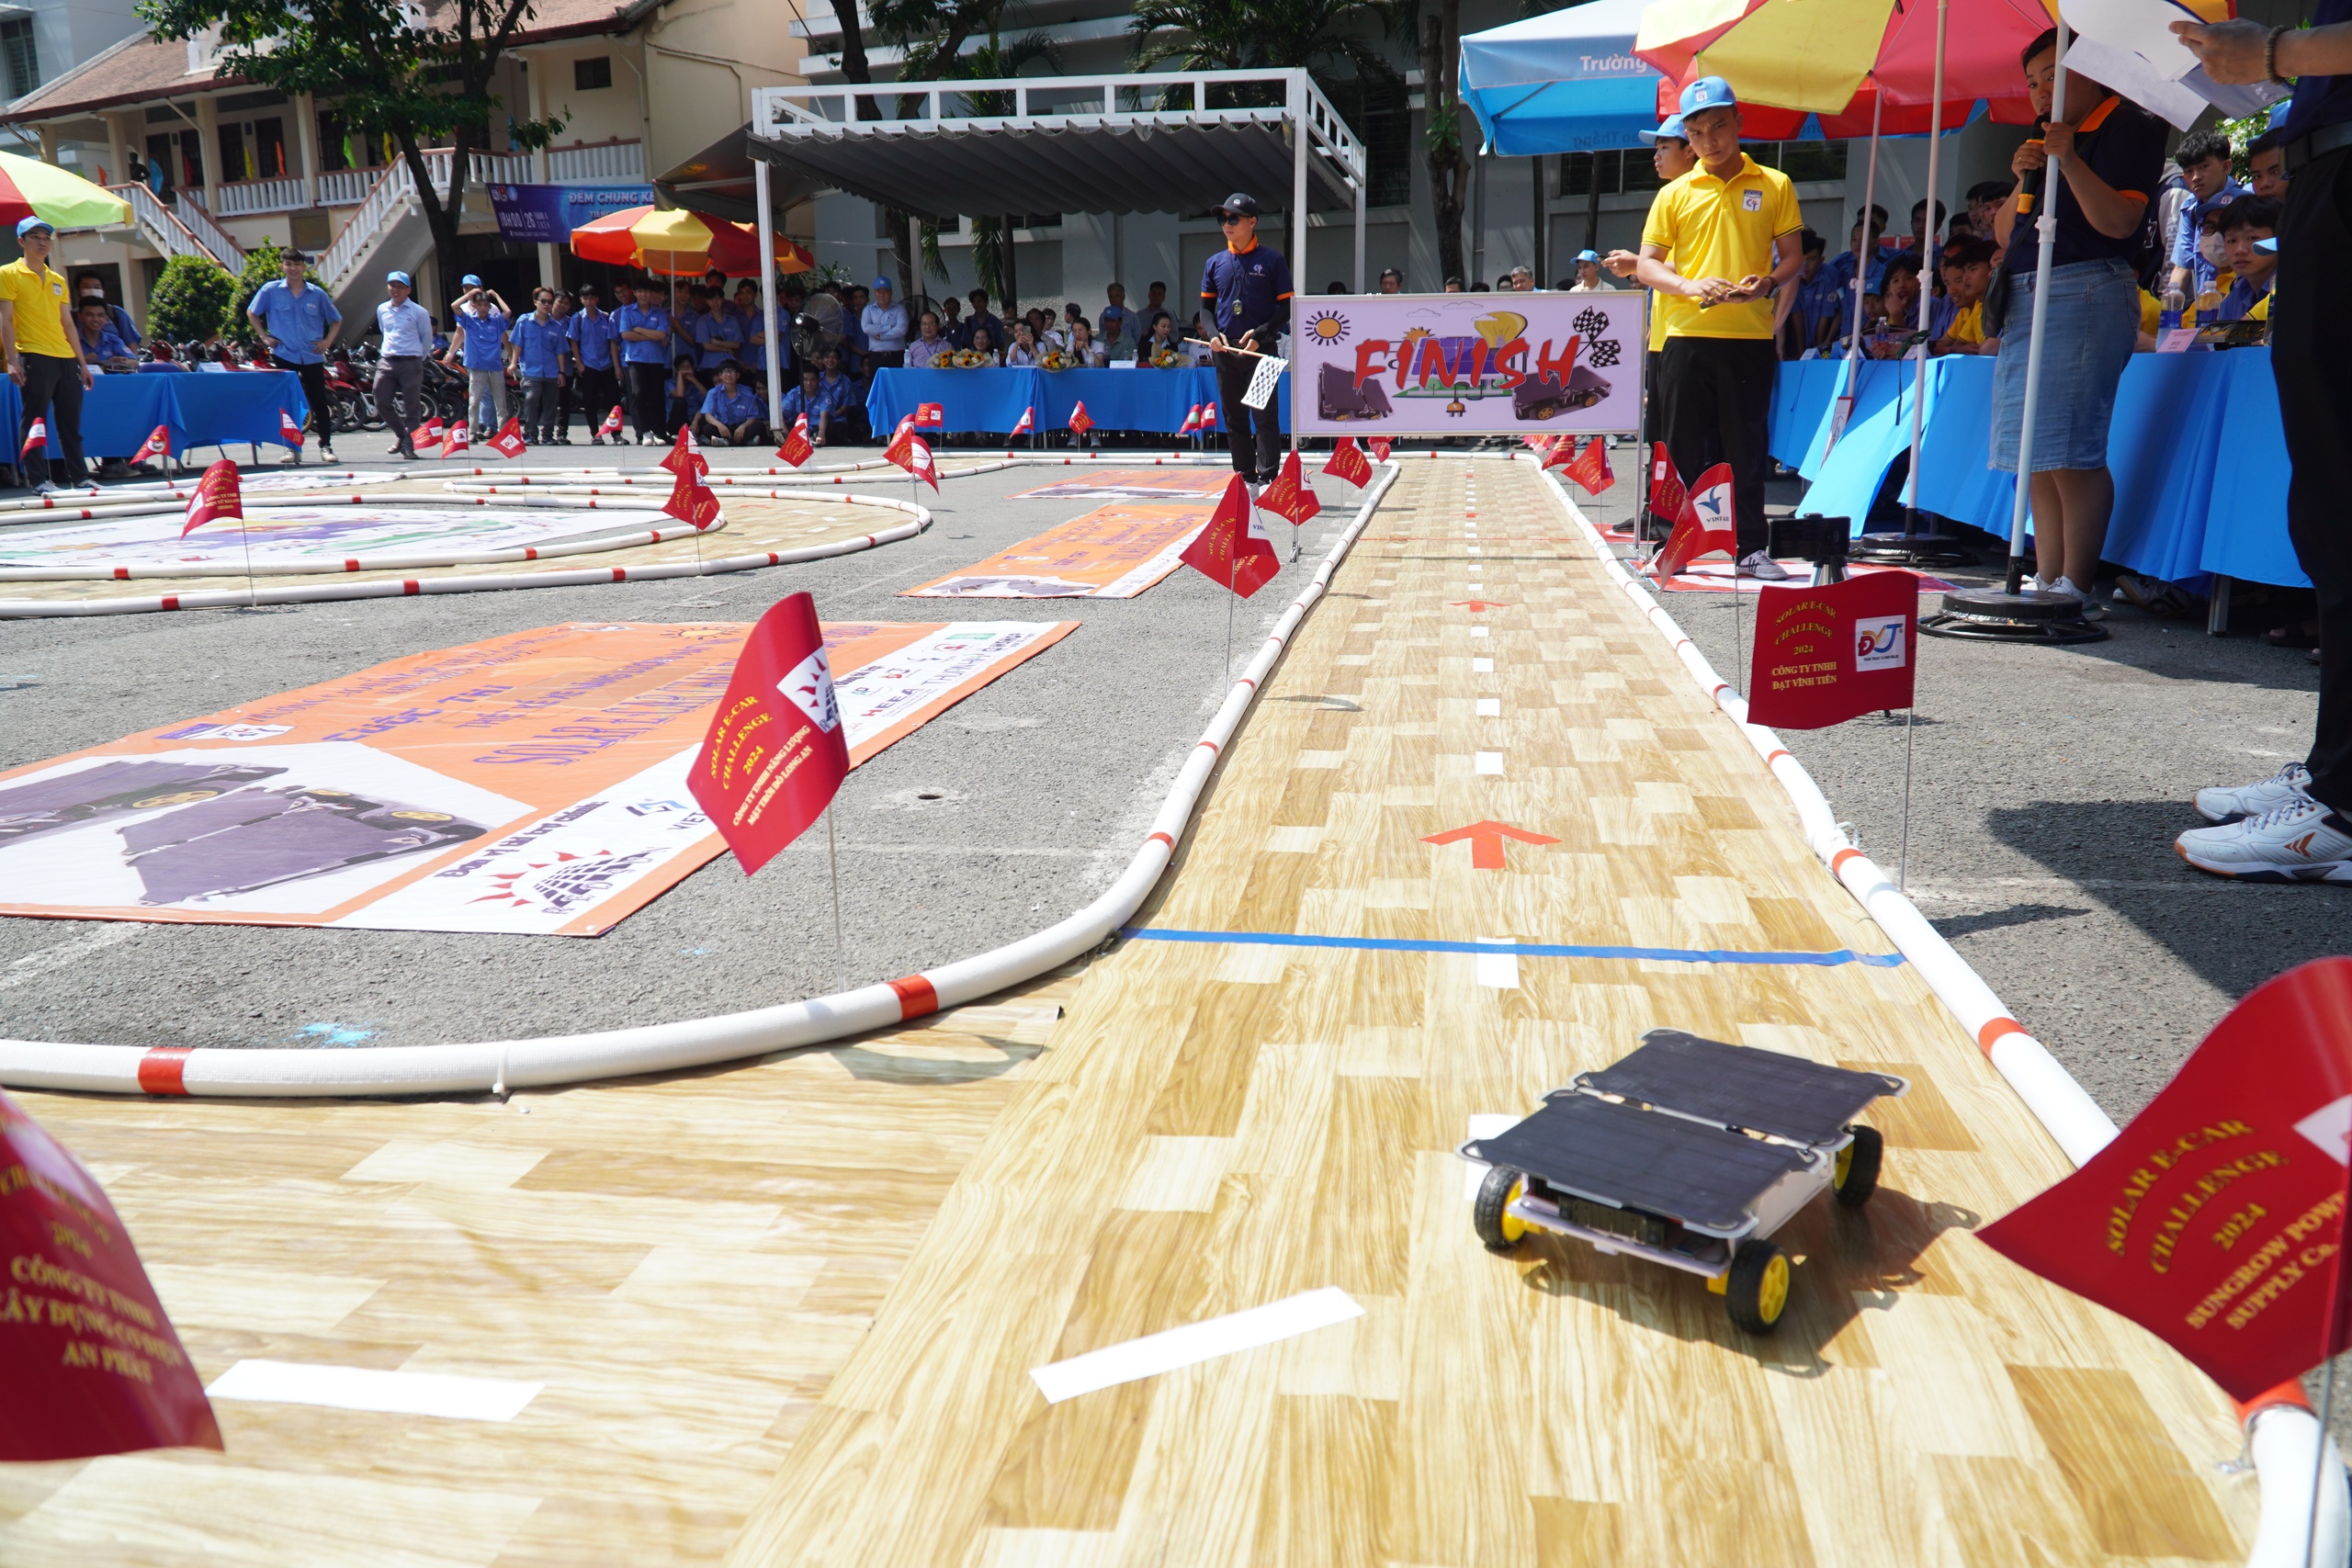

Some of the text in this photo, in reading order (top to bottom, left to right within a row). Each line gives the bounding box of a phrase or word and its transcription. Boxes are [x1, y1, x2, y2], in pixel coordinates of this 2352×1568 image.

[1580, 53, 1647, 73] Trường
[569, 190, 594, 204] ĐÊM
[597, 192, 638, 204] CHUNG
[1352, 334, 1581, 391] FINISH
[1208, 532, 1217, 557] SOLAR
[1775, 600, 1837, 626] SOLAR E-CAR
[1775, 623, 1834, 645] CHALLENGE
[1793, 644, 1814, 656] 2024
[1771, 661, 1838, 676] CÔNG TY TNHH
[1772, 680, 1791, 691] ĐẠT
[322, 685, 514, 741] CUỘC THI
[861, 688, 921, 716] HEEA
[471, 726, 645, 765] SOLAR
[710, 695, 759, 779] SOLAR E-CAR
[722, 712, 773, 790] CHALLENGE
[742, 745, 764, 775] 2024
[780, 755, 803, 779] LONG
[799, 745, 813, 759] AN
[732, 801, 749, 826] CÔNG
[744, 790, 755, 804] TY
[433, 859, 495, 877] Đơn
[2107, 1118, 2257, 1257] SOLAR E-CAR
[2148, 1148, 2290, 1275] CHALLENGE
[2212, 1201, 2269, 1253] 2024
[10, 1253, 83, 1297] CÔNG
[2185, 1235, 2290, 1330] SUNGROW
[2225, 1258, 2306, 1330] SUPPLY
[62, 1339, 98, 1370] AN
